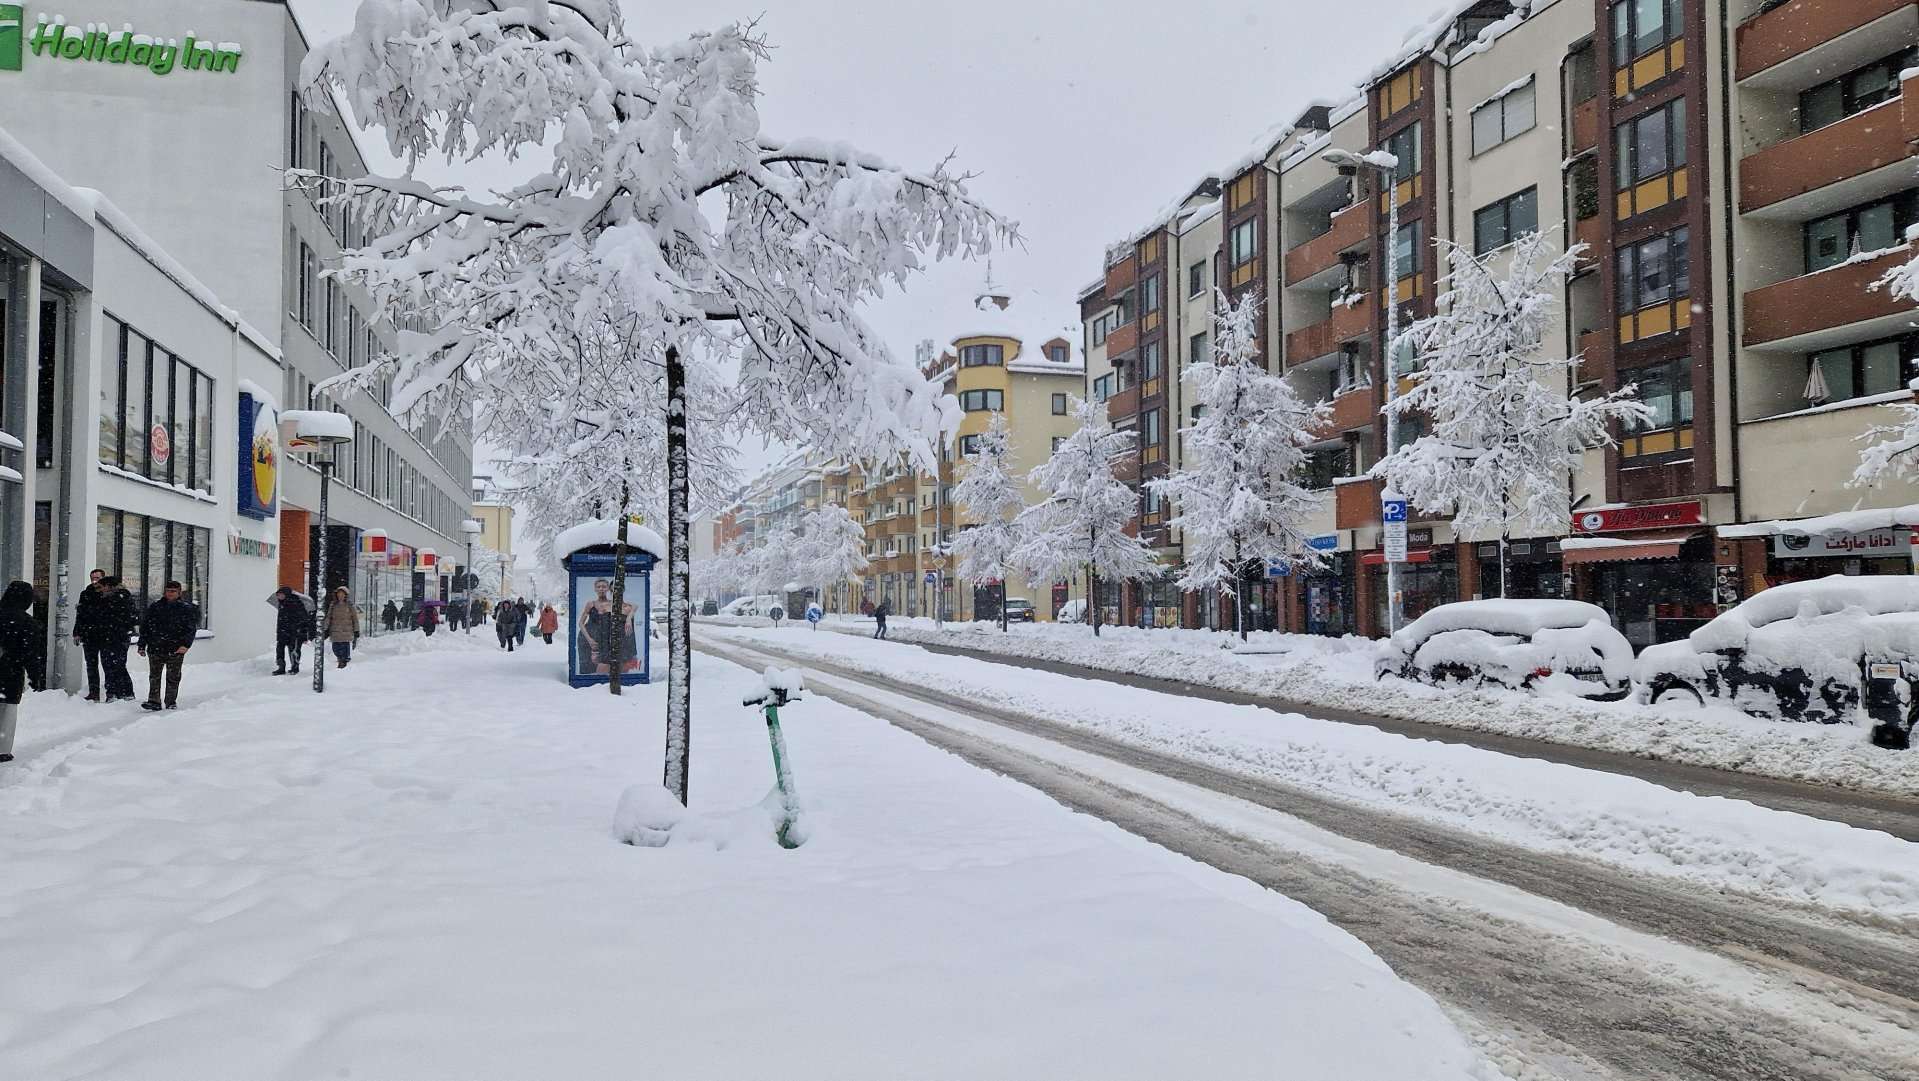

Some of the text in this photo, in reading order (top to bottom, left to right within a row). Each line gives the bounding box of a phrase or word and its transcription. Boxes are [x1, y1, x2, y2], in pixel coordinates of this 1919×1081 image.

[30, 23, 239, 75] Holiday Inn
[1409, 533, 1429, 542] Moda
